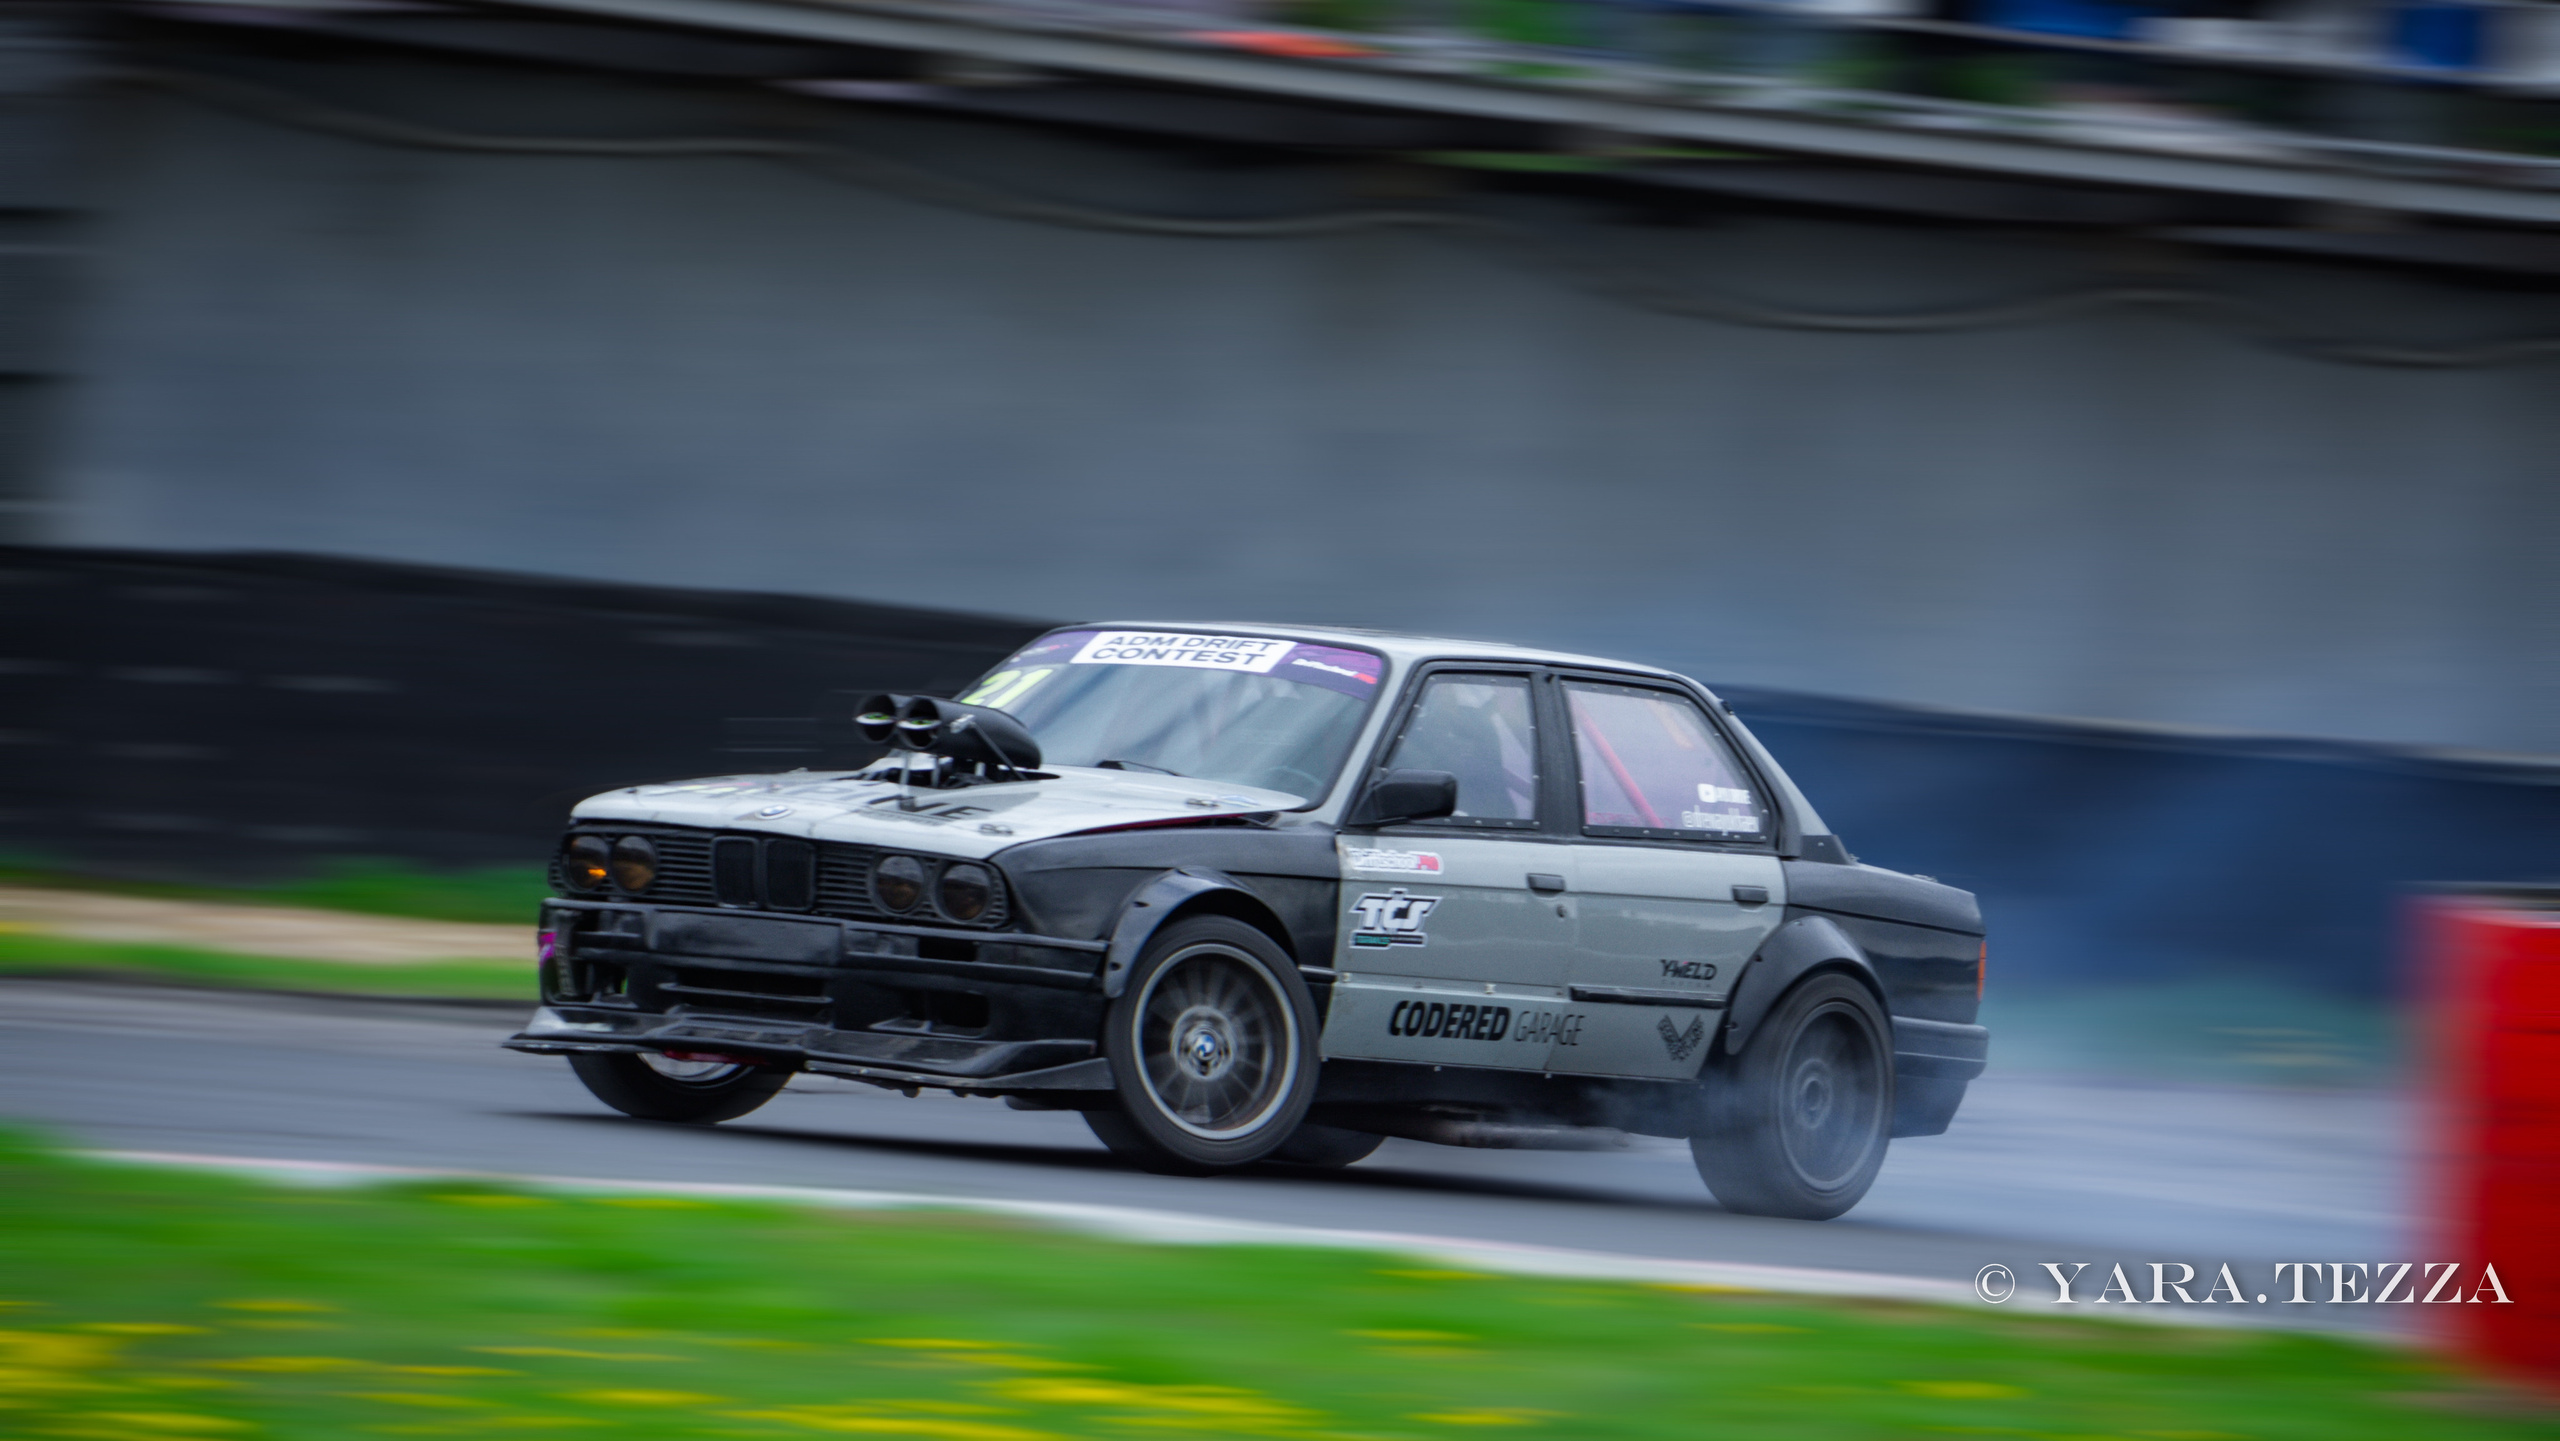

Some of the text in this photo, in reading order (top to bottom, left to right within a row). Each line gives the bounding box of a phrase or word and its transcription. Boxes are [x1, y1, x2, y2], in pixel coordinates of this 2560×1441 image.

[1091, 647, 1266, 666] CONTEST
[1103, 635, 1280, 653] ADM DRIFT
[960, 669, 1053, 709] 21
[1388, 1000, 1586, 1046] CODERED GARAGE
